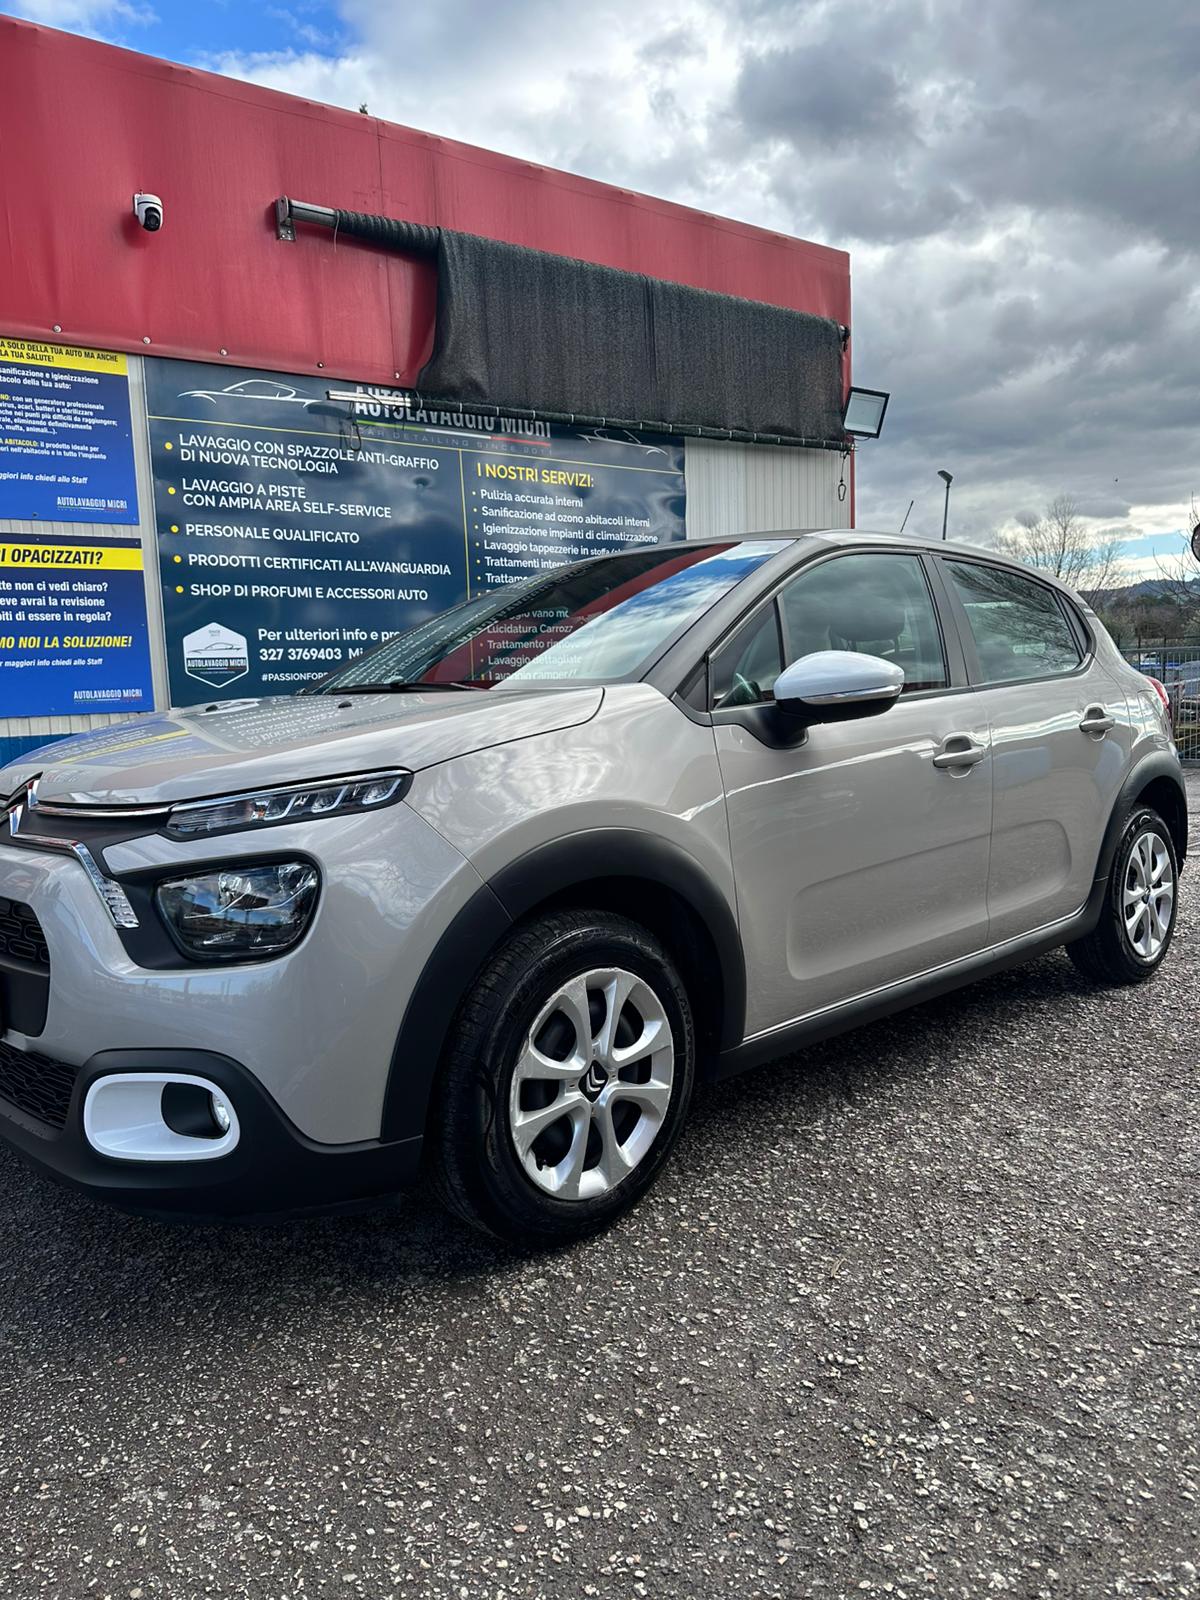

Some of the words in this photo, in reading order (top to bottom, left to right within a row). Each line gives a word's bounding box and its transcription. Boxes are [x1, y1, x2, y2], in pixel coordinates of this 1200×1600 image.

[8, 341, 25, 350] SOLO
[27, 343, 48, 353] DELLA
[50, 346, 63, 355] TUA
[65, 348, 82, 357] AUTO
[84, 350, 95, 359] MA
[96, 352, 118, 362] ANCHE
[11, 351, 24, 359] TUA
[26, 352, 54, 363] SALUTE!
[23, 377, 40, 387] della
[42, 379, 52, 388] tua
[51, 372, 99, 385] igienizzazione
[179, 433, 251, 451] LAVAGGIO
[253, 441, 284, 455] CON
[287, 444, 355, 461] SPAZZOLE
[357, 451, 439, 470] ANTI-GRAFFIO
[181, 449, 195, 462] DI
[199, 450, 251, 467] NUOVA
[251, 455, 339, 474] TECNOLOGIA
[20, 473, 34, 481] info
[35, 474, 57, 482] chiedi
[72, 476, 89, 484] Staff
[477, 462, 482, 477] I
[485, 463, 538, 482] NOSTRI
[541, 470, 594, 488] SERVIZI:
[182, 477, 254, 494] LAVAGGIO
[257, 484, 267, 496] A
[269, 484, 306, 499] PISTE
[57, 496, 106, 508] AUTOLAVAGGIO
[107, 499, 128, 509] MICRI
[481, 489, 513, 502] Pulizia
[515, 494, 554, 505] accurata
[555, 496, 584, 508] interni
[183, 493, 216, 507] CON
[219, 495, 264, 510] AMPIA
[265, 499, 302, 513] AREA
[303, 501, 392, 519] SELF-SERVICE
[482, 506, 543, 520] Sanificazione
[545, 511, 556, 522] ad
[558, 515, 584, 524] ozono
[585, 514, 623, 526] abitacoli
[625, 516, 651, 528] interni
[185, 523, 271, 540] PERSONALE
[272, 528, 360, 544] QUALIFICATO
[483, 523, 548, 537] Igienizzazione
[549, 527, 584, 541] impianti
[586, 530, 595, 540] di
[596, 531, 659, 545] climatizzazione
[484, 540, 528, 554] Lavaggio
[530, 542, 579, 555] tappezzerie
[581, 546, 588, 555] in
[11, 548, 104, 565] OPACIZZATI?
[485, 557, 539, 569] Trattamenti
[188, 553, 261, 568] PRODOTTI
[263, 556, 342, 571] CERTIFICATI
[345, 560, 452, 575] ALL'AVANGUARDIA
[15, 582, 34, 591] non
[37, 582, 46, 591] ci
[48, 582, 70, 592] vedi
[72, 582, 108, 592] chiaro?
[190, 583, 231, 597] SHOP
[234, 585, 248, 597] DI
[251, 585, 312, 599] PROFUMI
[316, 587, 324, 599] E
[326, 588, 395, 600] ACCESSORI
[398, 589, 428, 601] AUTO
[21, 596, 46, 606] avrai
[49, 596, 58, 606] la
[61, 597, 105, 607] revisione
[16, 611, 26, 621] di
[29, 612, 62, 621] essere
[64, 611, 73, 621] in
[76, 611, 112, 623] regola?
[532, 610, 555, 618] vano
[259, 629, 282, 641] Per
[285, 629, 339, 641] ulteriori
[343, 629, 367, 641] info
[370, 631, 379, 641] e
[487, 624, 538, 634] Lucidatura
[18, 637, 41, 649] NOI
[44, 637, 60, 649] LA
[63, 636, 133, 649] SOLUZIONE!
[487, 640, 545, 650] Trattamento
[260, 648, 284, 661] 327
[288, 648, 342, 661] 3769403
[489, 655, 531, 667] Lavaggio
[5, 659, 36, 669] maggiori
[37, 659, 51, 667] info
[52, 658, 72, 667] chiedi
[73, 658, 86, 666] allo
[188, 659, 229, 668] AUTOLAVAGGIO
[74, 690, 122, 700] AUTOLAVAGGIO
[123, 689, 143, 698] MICRI
